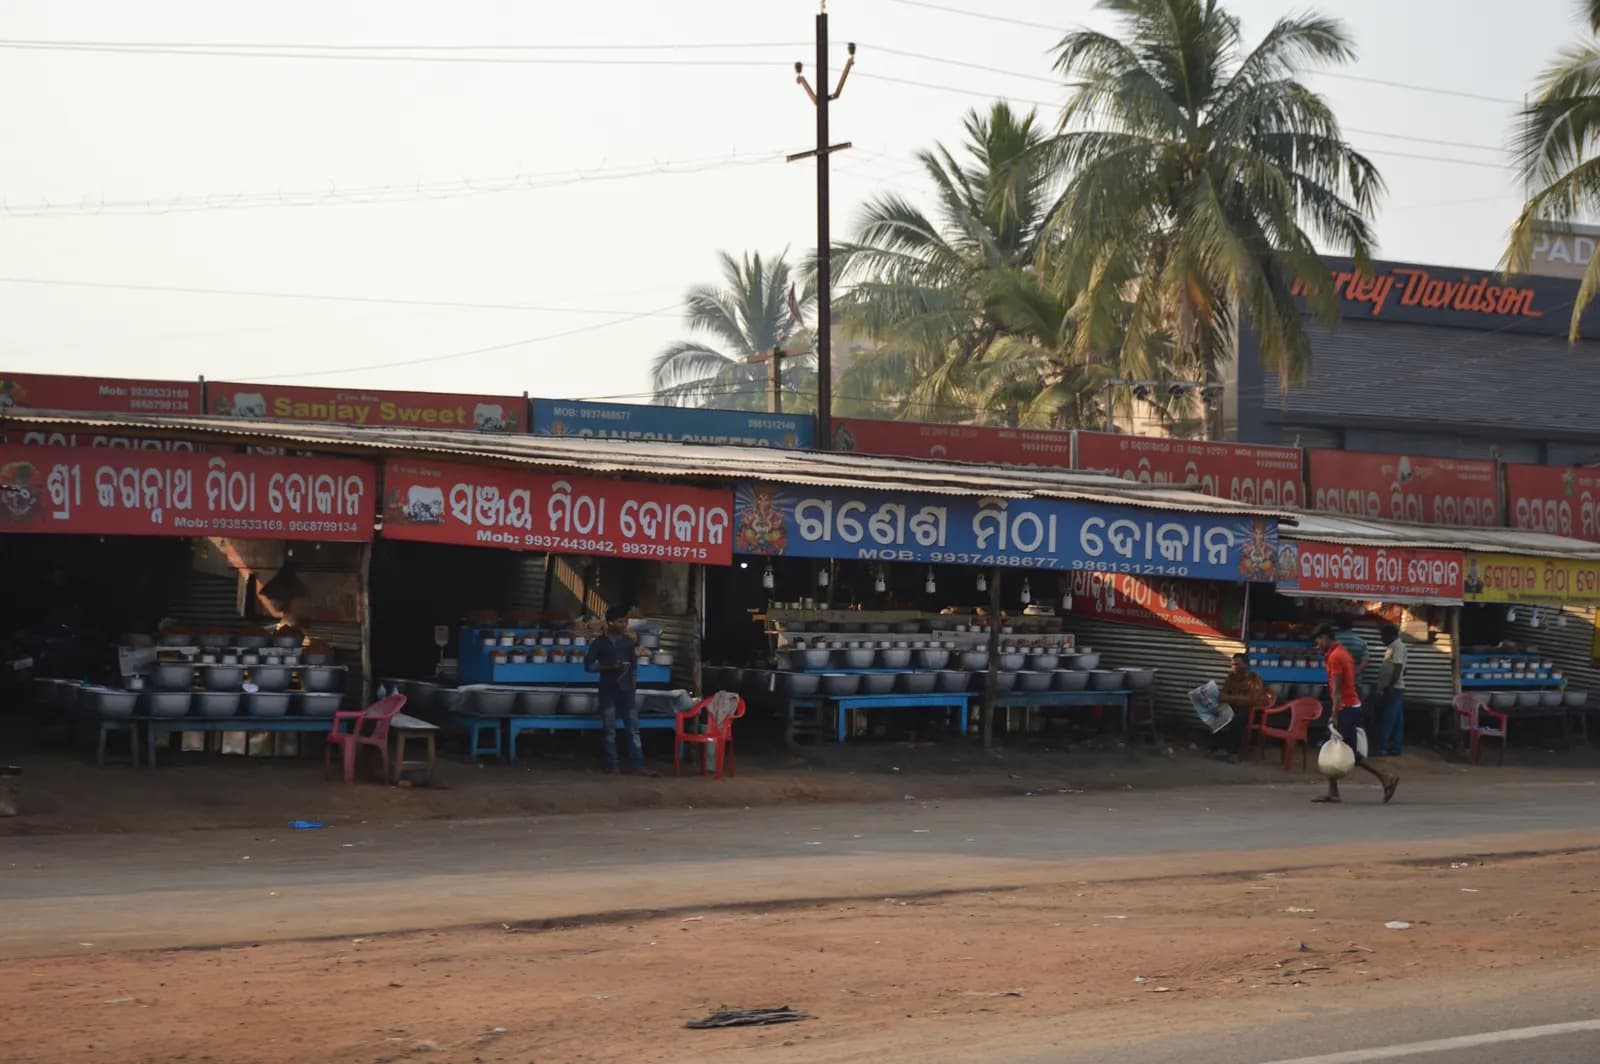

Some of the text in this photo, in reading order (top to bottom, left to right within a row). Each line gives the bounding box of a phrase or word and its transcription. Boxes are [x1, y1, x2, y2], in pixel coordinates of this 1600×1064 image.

[1290, 267, 1544, 317] rley-Davidson
[274, 396, 466, 424] Sanjay Sweet
[47, 456, 364, 524] ଶ୍ରୀ ଜଗନ୍ନାଥ ମିଠା ଦୋକାନ
[174, 516, 208, 528] Mob:
[547, 480, 605, 536] ମିଠା
[619, 499, 729, 545] ଦୋକାନ
[476, 530, 708, 559] Mob: 9937443042, 9937818715
[794, 497, 1235, 565] ଗଣେଶ ମିଠା ଦୋକାନ
[857, 548, 922, 562] MOB:
[1071, 559, 1189, 577] 9861312140
[1375, 549, 1403, 583] ମିଠା
[1407, 559, 1460, 586] ଦୋକାନ
[1543, 560, 1569, 592] ମିଠା
